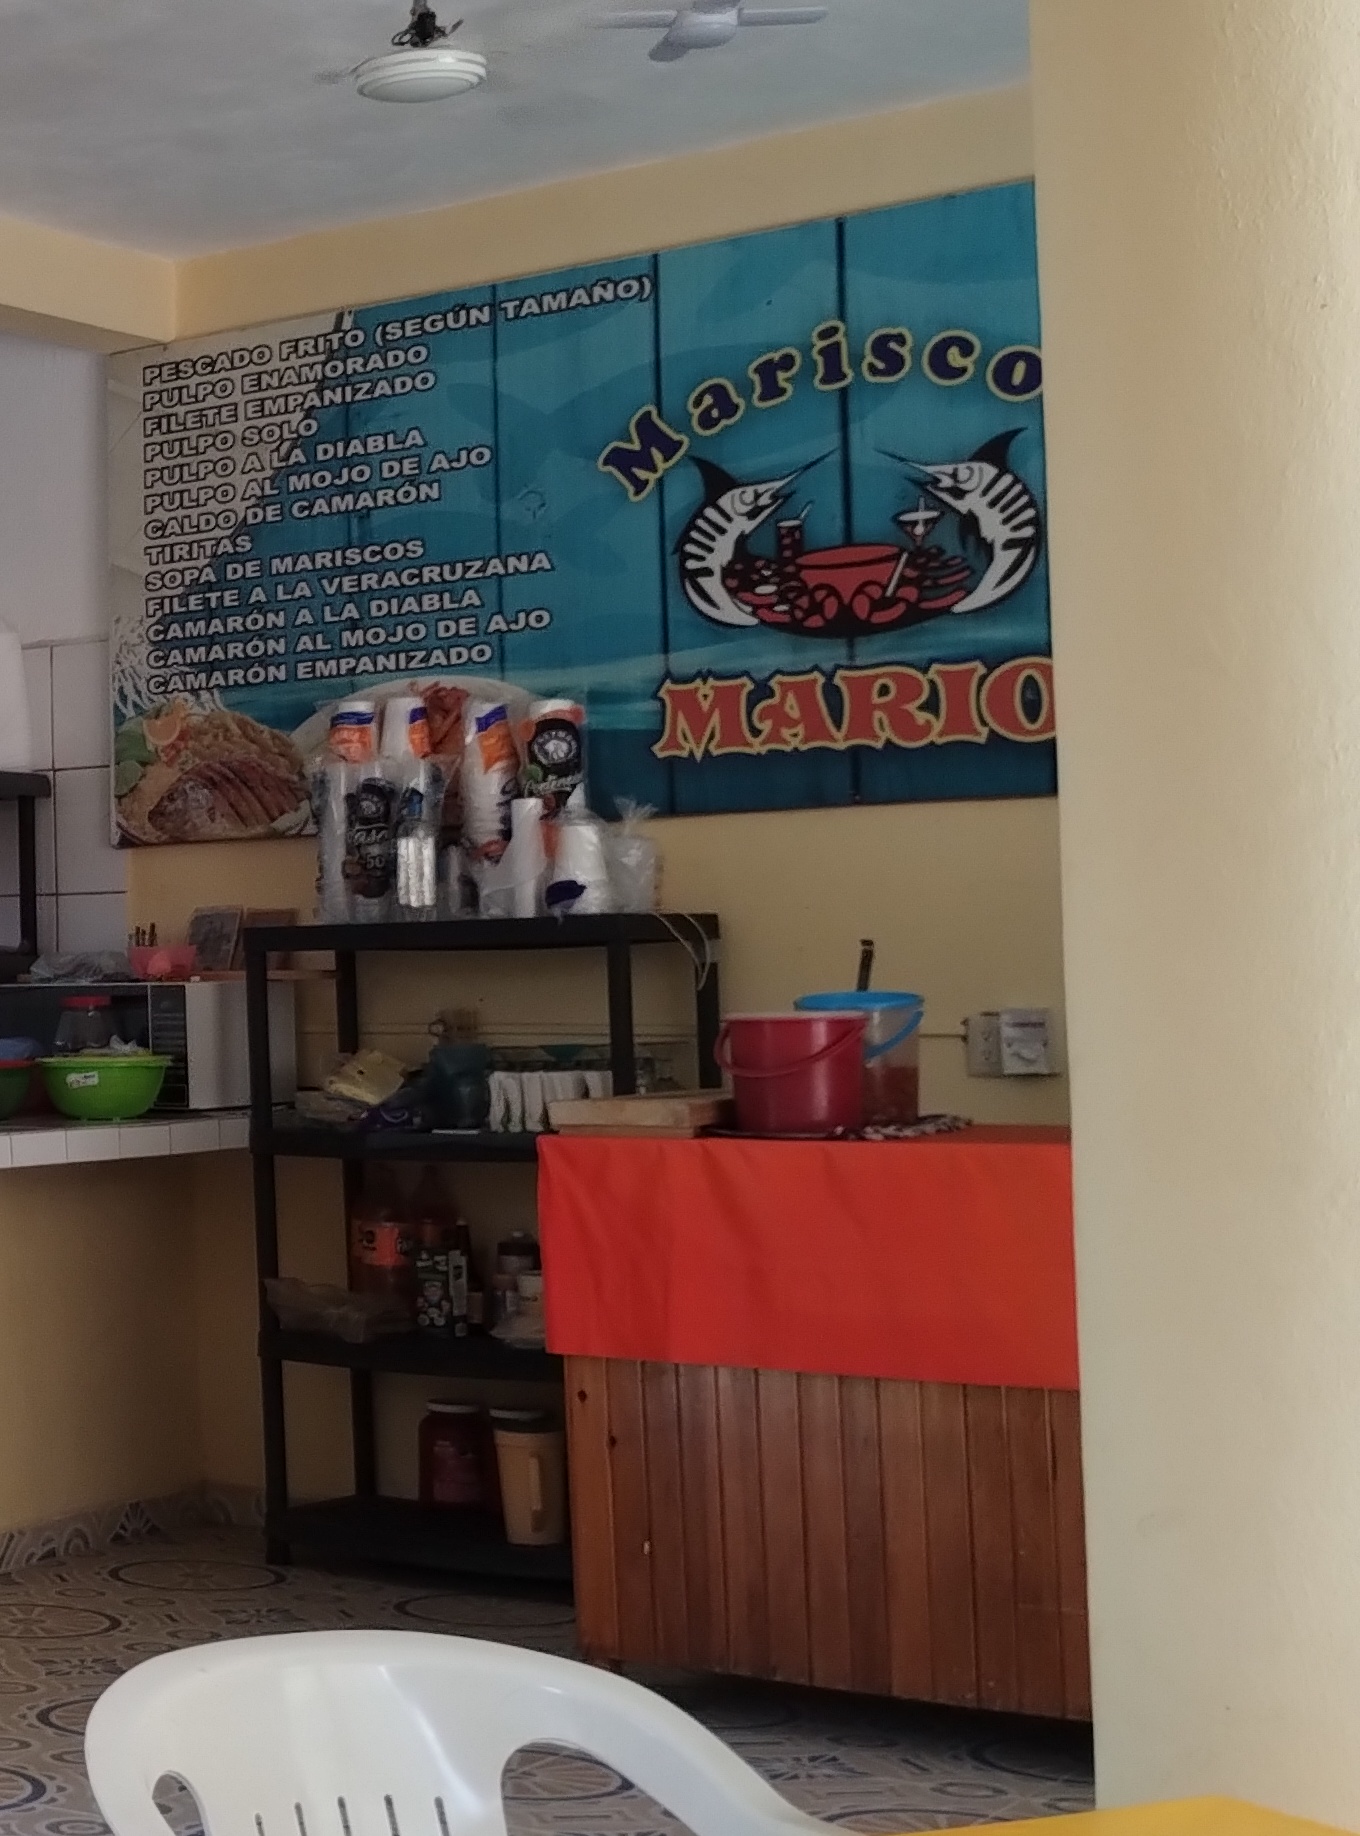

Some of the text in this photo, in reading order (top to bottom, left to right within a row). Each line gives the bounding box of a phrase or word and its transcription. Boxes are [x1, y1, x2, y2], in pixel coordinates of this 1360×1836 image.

[143, 277, 652, 386] PESCADO FRITO (SEGÚN TAMAÑO)
[143, 345, 429, 412] PULPO ENAMORADO
[143, 371, 436, 437] FILETE EMPANIZADO
[143, 418, 318, 462] PULPO SOLO
[144, 428, 426, 489] PULPO A LA DIABLA
[144, 445, 493, 515] PULPO AL MOJO DE AJO
[144, 481, 442, 540] CALDO DE CAMARÓN
[144, 534, 253, 566] TIRITAS
[145, 538, 425, 592] SOPA DE MARISCOS
[145, 551, 553, 619] FILETE A LA VERACRUZANA
[145, 588, 482, 643] CAMARÓN A LA DIABLA
[145, 608, 553, 669] CAMARÓN AL MOJO DE AJO
[146, 642, 493, 694] CAMARÓN EMPANIZADO
[653, 656, 1056, 761] MARIO
